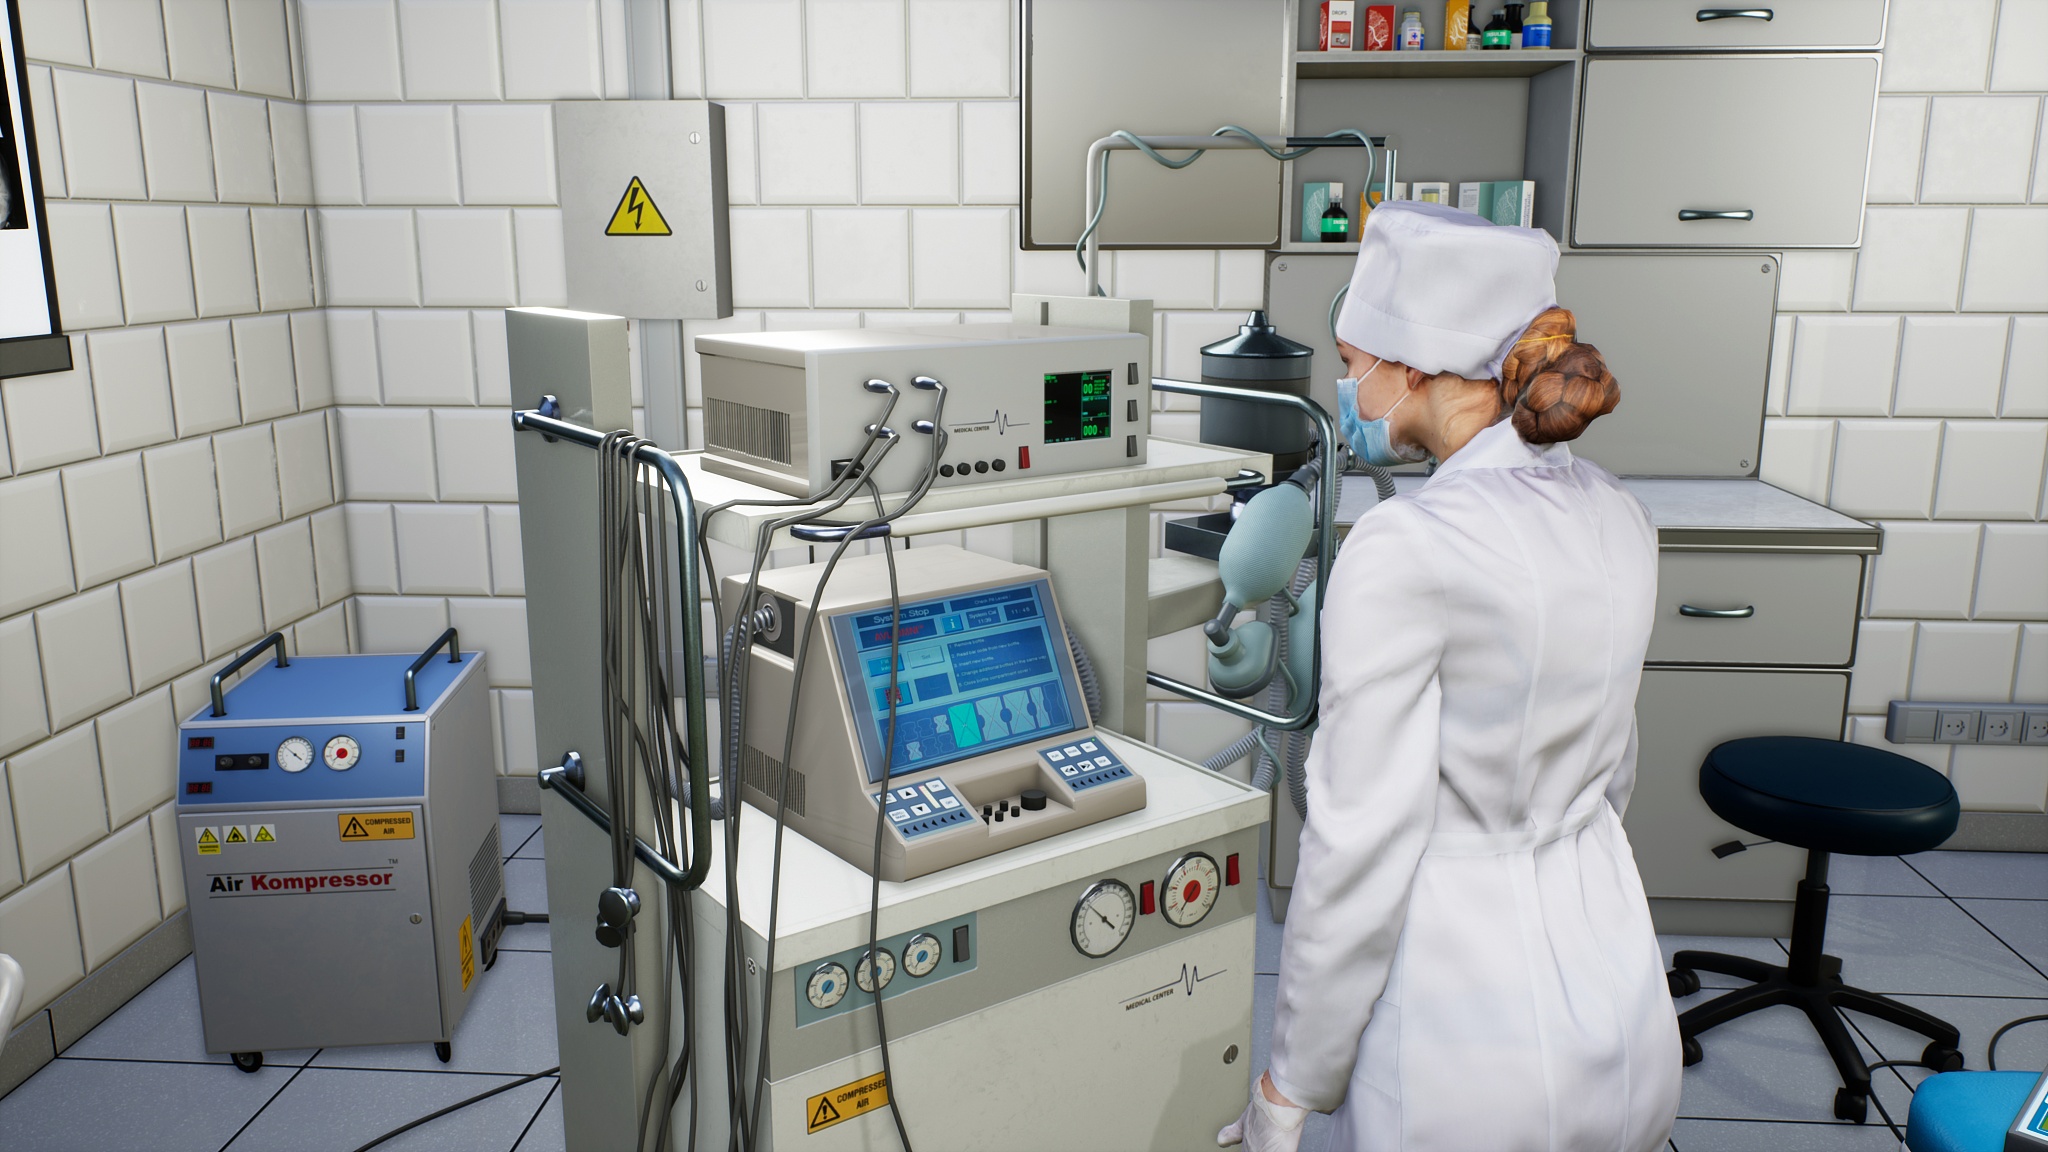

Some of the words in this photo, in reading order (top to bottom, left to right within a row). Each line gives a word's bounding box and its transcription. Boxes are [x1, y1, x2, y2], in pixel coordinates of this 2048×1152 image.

[953, 426, 973, 434] MEDICAL
[873, 612, 907, 624] Systm
[908, 608, 930, 617] Stop
[364, 817, 411, 826] COMPRESSED
[210, 876, 244, 893] Air
[251, 873, 393, 893] Kompressor
[1125, 996, 1152, 1012] MEDICAL
[1152, 988, 1174, 1001] CENTER
[836, 1078, 887, 1104] COMPRESSED
[856, 1097, 870, 1110] AIR
